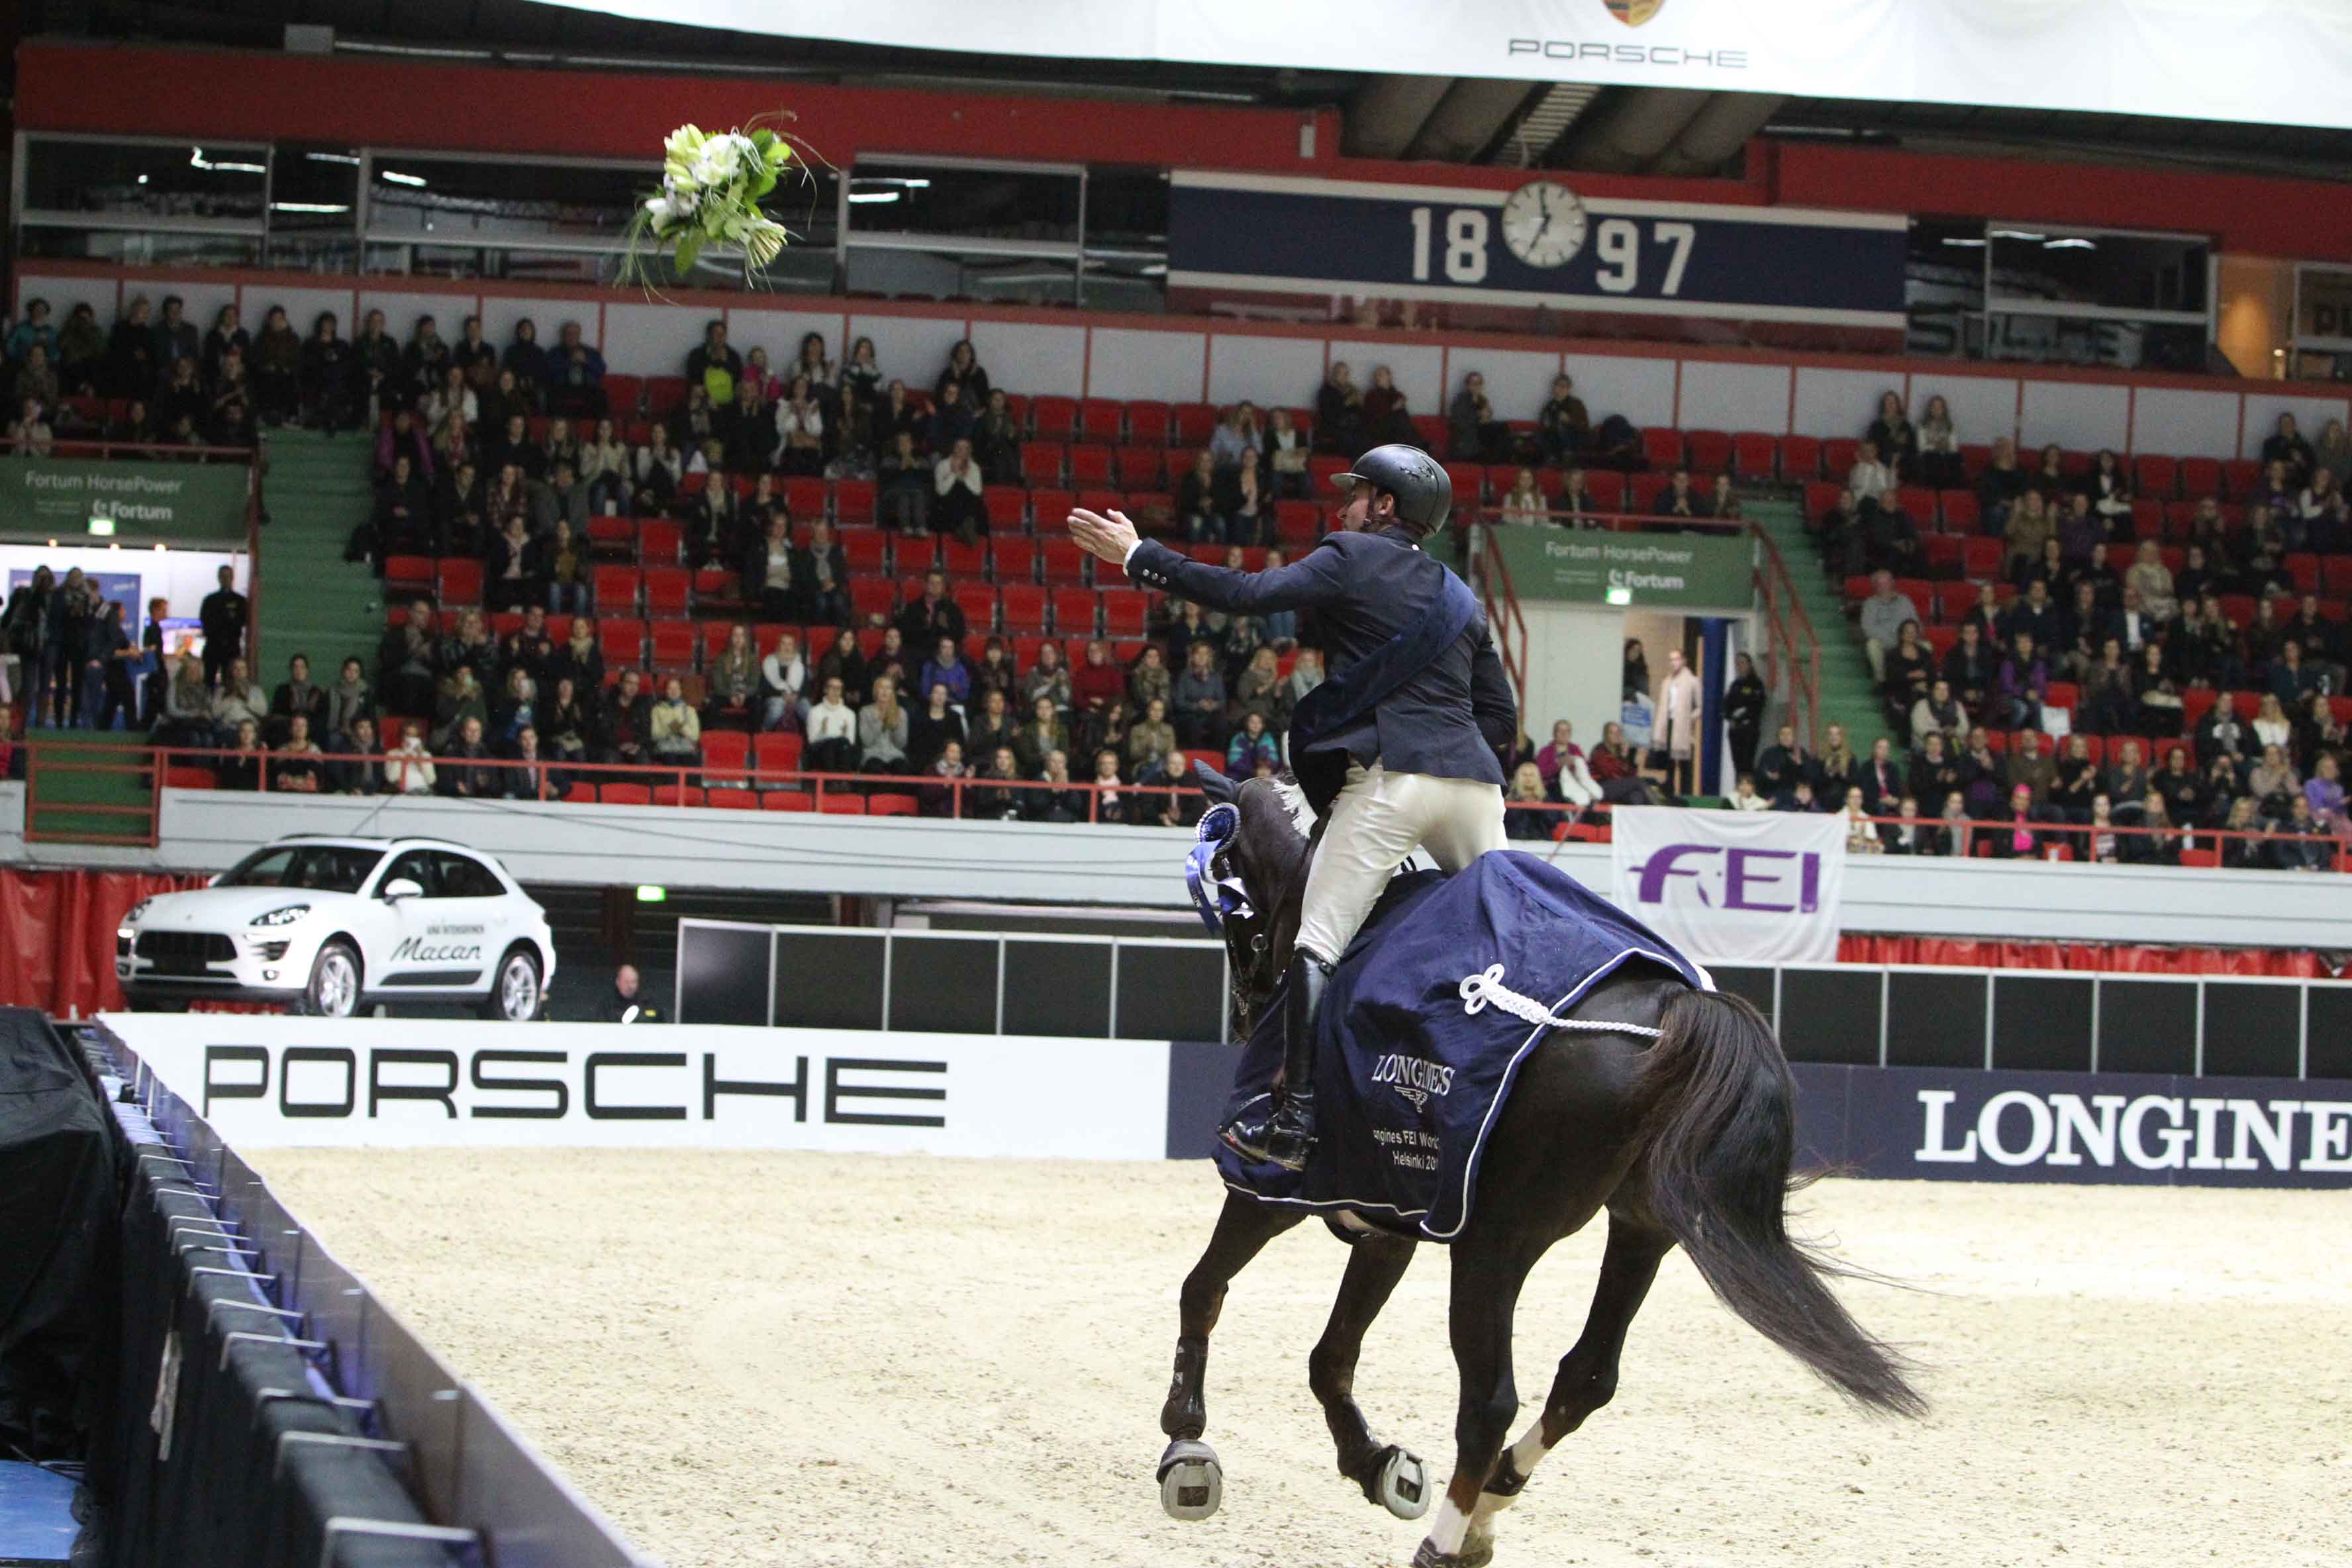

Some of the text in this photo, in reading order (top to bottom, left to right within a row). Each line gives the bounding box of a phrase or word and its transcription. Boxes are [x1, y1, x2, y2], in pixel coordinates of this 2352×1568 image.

[1508, 38, 1749, 68] PORSCHE
[1411, 206, 1695, 296] 18 97
[25, 471, 182, 493] Fortum HorsePower
[110, 501, 173, 520] Fortum
[1546, 541, 1693, 563] Fortum HorsePower
[1625, 571, 1685, 589] Fortum
[1628, 844, 1820, 914] FEI
[389, 936, 481, 961] Macan
[203, 1045, 948, 1127] PORSCHE
[1371, 1054, 1456, 1097] LONGINES
[1402, 1130, 1417, 1146] FEI
[1916, 1090, 2352, 1172] LONGINE
[1393, 1150, 1424, 1170] Helsinki
